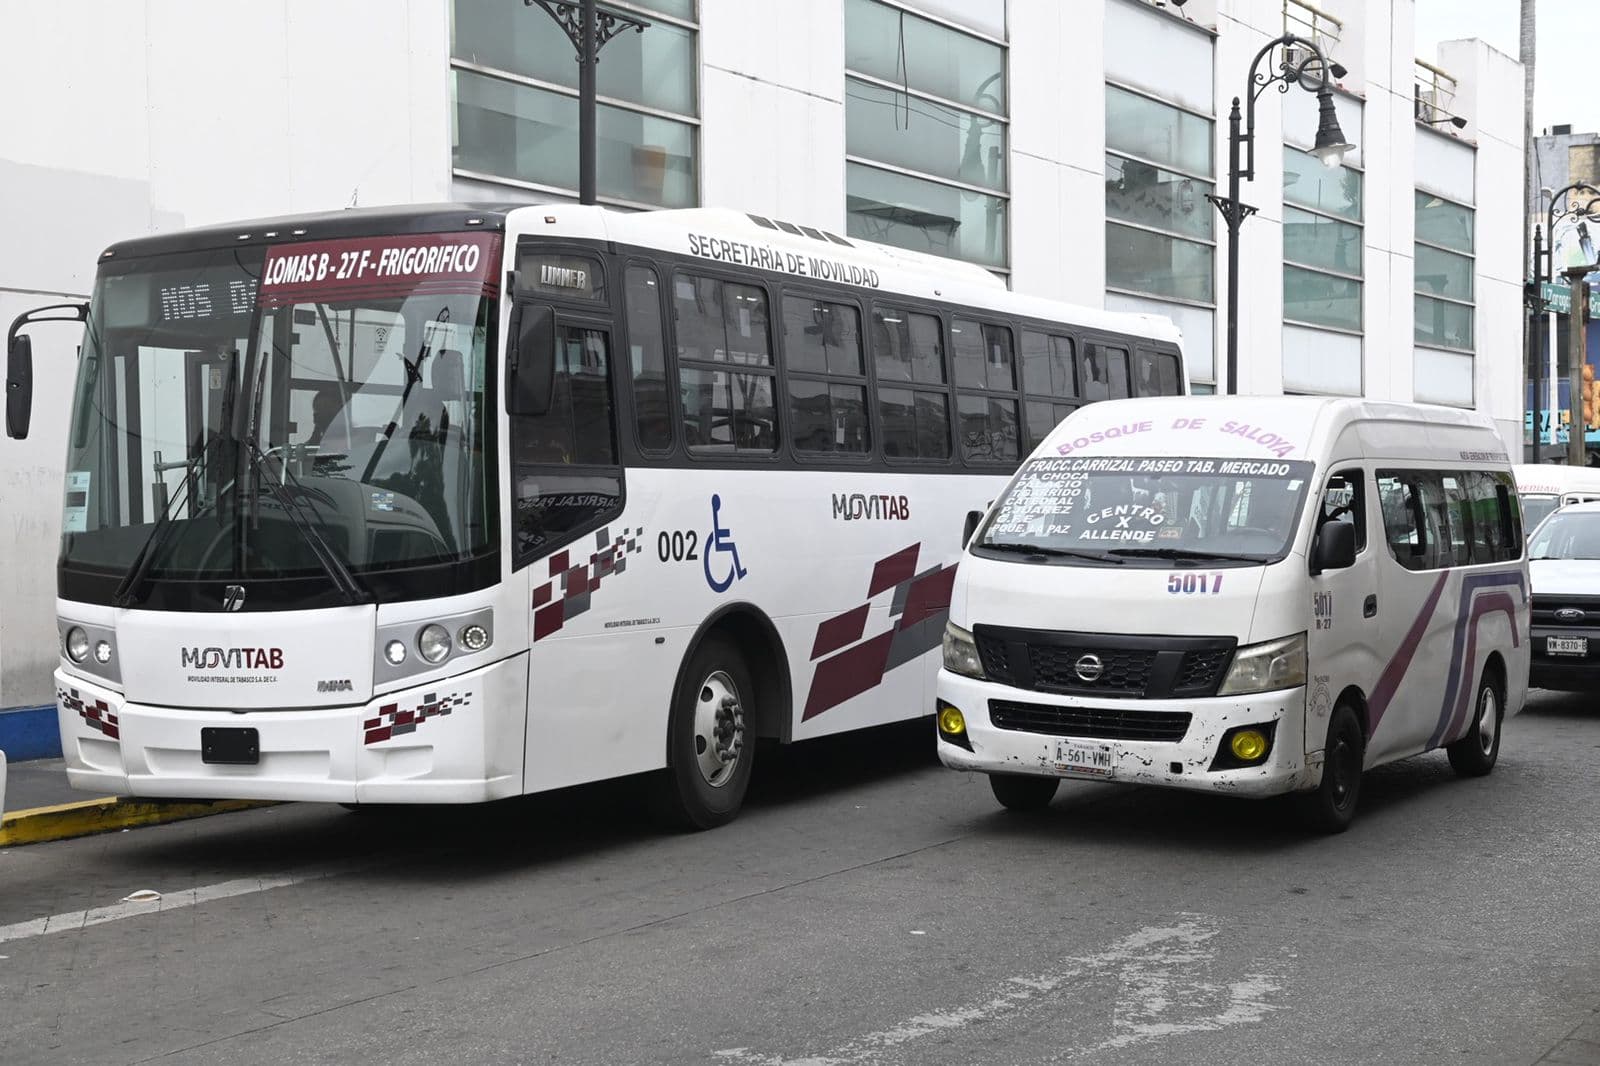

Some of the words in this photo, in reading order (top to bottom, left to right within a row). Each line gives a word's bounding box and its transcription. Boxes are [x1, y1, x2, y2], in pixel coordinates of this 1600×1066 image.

[264, 253, 317, 285] LOMAS
[316, 252, 330, 281] B
[377, 244, 480, 276] FRIGORIFICO
[688, 233, 784, 271] SECRETARÍA
[787, 253, 806, 275] DE
[808, 257, 879, 288] MOVILIDAD
[1056, 421, 1153, 456] BOSQUE
[1171, 418, 1207, 430] DE
[1219, 421, 1296, 458] SALOYA
[1020, 473, 1038, 481] LA
[1041, 472, 1089, 481] CHOCA
[1137, 460, 1185, 473] PASEO
[1187, 461, 1215, 473] TAB.
[1219, 461, 1290, 476] MERCADO
[832, 493, 909, 520] MOVITAB
[1086, 504, 1165, 525] CENTRO
[1047, 524, 1071, 534] PAZ
[1115, 516, 1132, 528] X
[657, 530, 698, 562] 002
[1079, 530, 1156, 541] ALLENDE
[1168, 572, 1223, 594] 5017
[1313, 591, 1332, 617] 5017
[181, 647, 284, 669] MOVITAB
[1056, 747, 1111, 767] A-561-VMH
